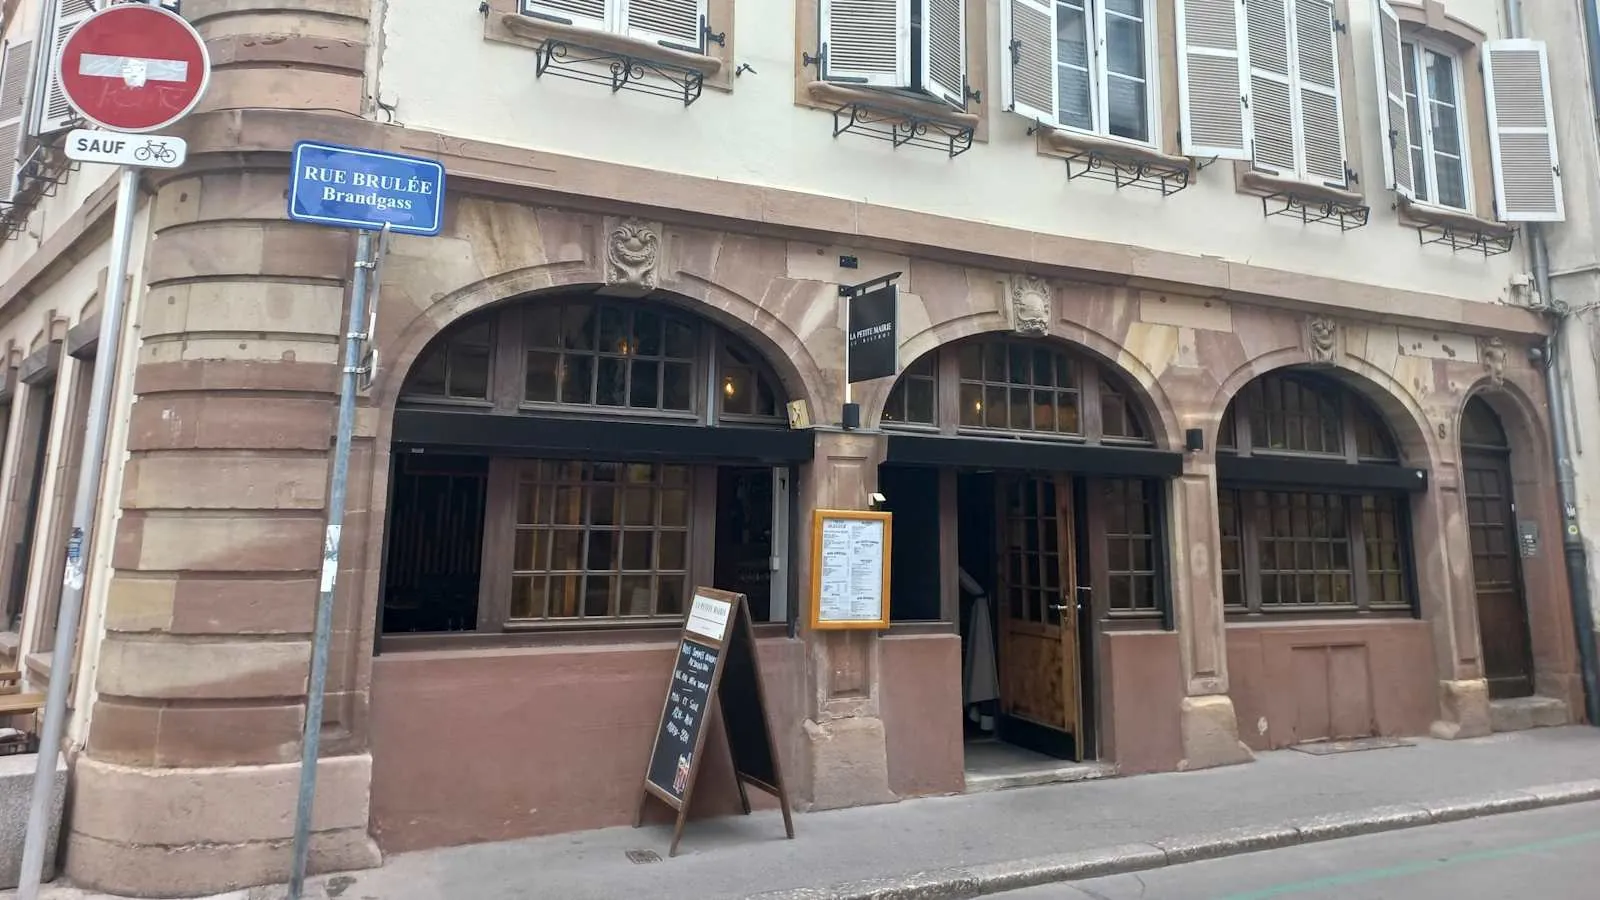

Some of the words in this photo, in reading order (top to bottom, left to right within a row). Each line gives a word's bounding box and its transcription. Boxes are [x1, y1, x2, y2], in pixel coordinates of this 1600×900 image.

[77, 138, 126, 154] SAUF
[304, 165, 347, 185] RUE
[352, 172, 433, 195] BRULÉE
[322, 186, 412, 210] Brandgass
[850, 332, 857, 341] LA
[857, 327, 873, 339] PETITE
[873, 322, 892, 334] MAIRIE
[1438, 423, 1446, 440] 8
